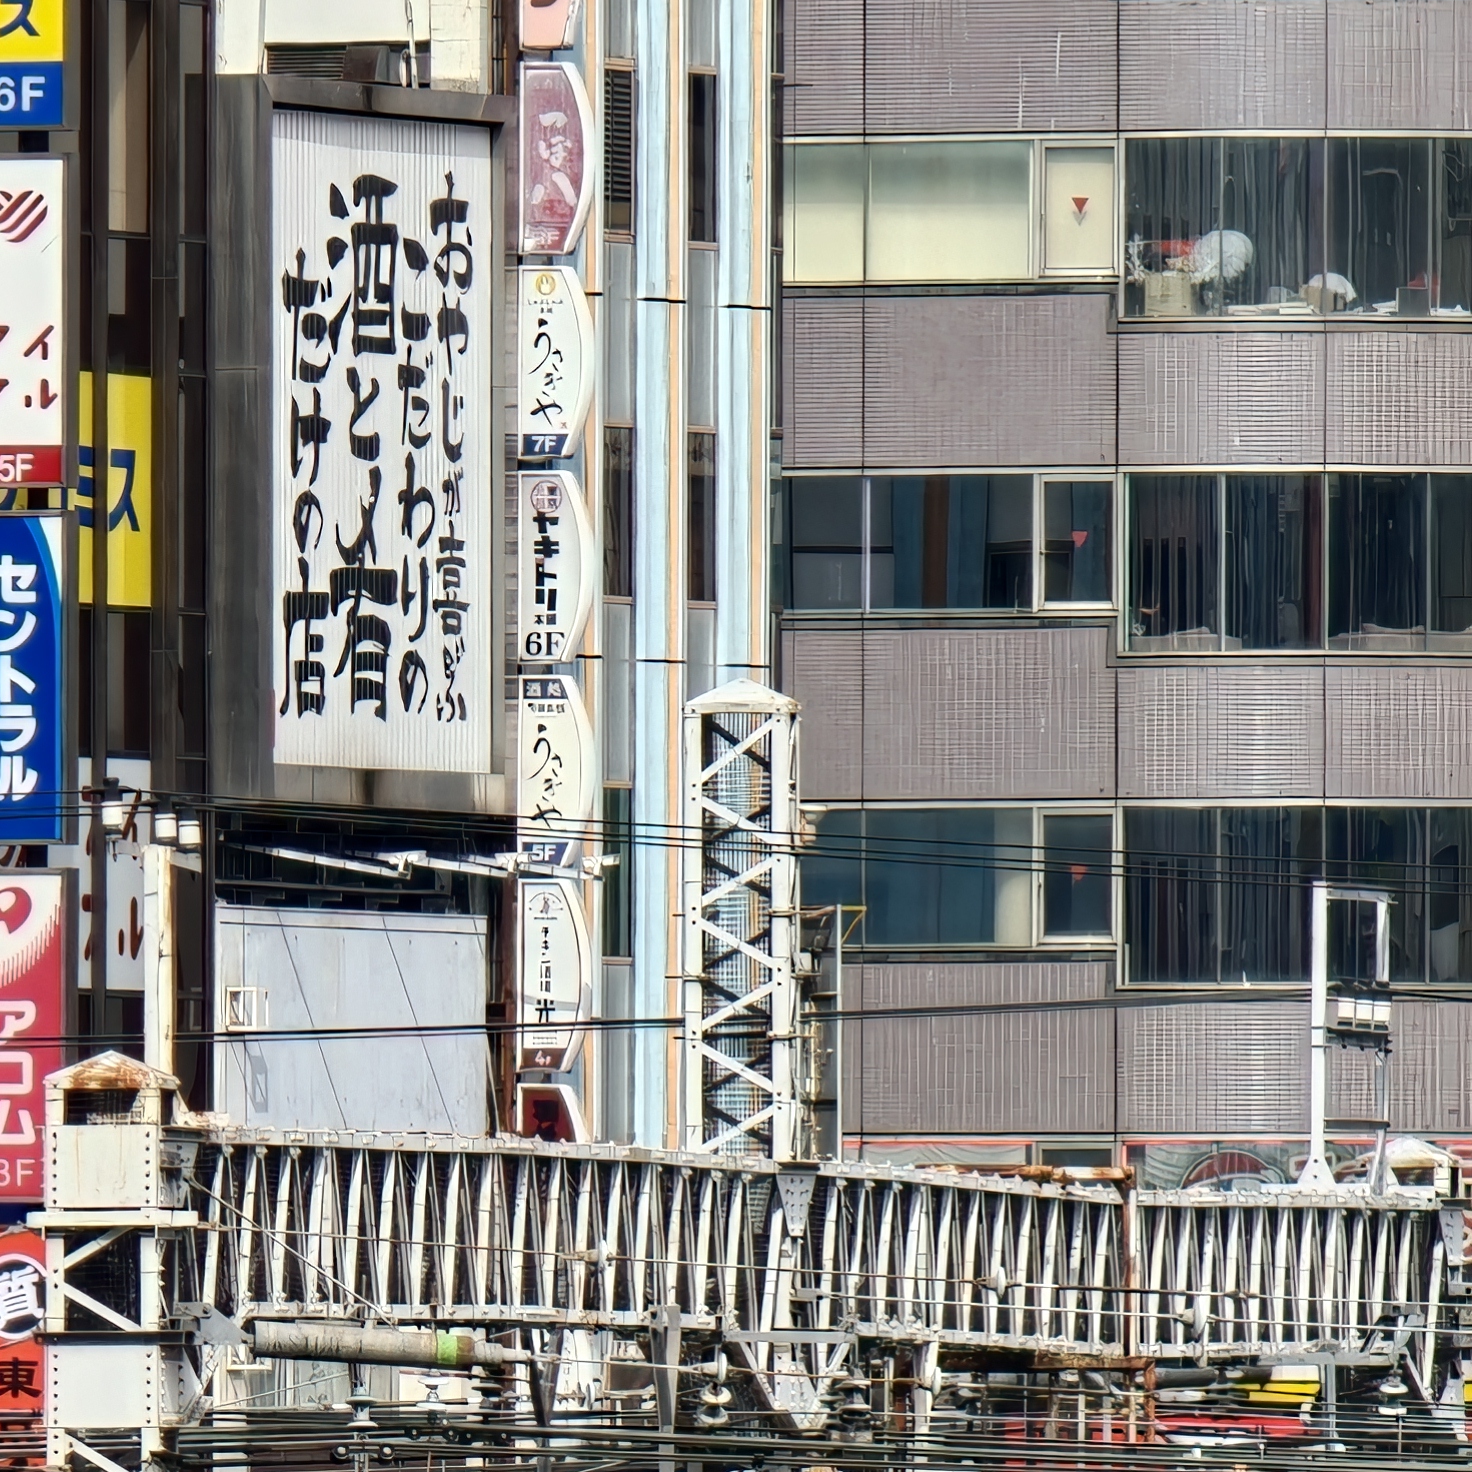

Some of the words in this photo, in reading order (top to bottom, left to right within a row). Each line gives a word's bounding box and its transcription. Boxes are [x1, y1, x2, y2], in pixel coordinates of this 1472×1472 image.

[528, 317, 564, 428] うさぎや
[328, 172, 399, 722] 酒と肴
[531, 436, 557, 453] 7F
[279, 247, 332, 719] だけの店
[525, 631, 565, 656] 6F
[531, 845, 557, 861] 5F
